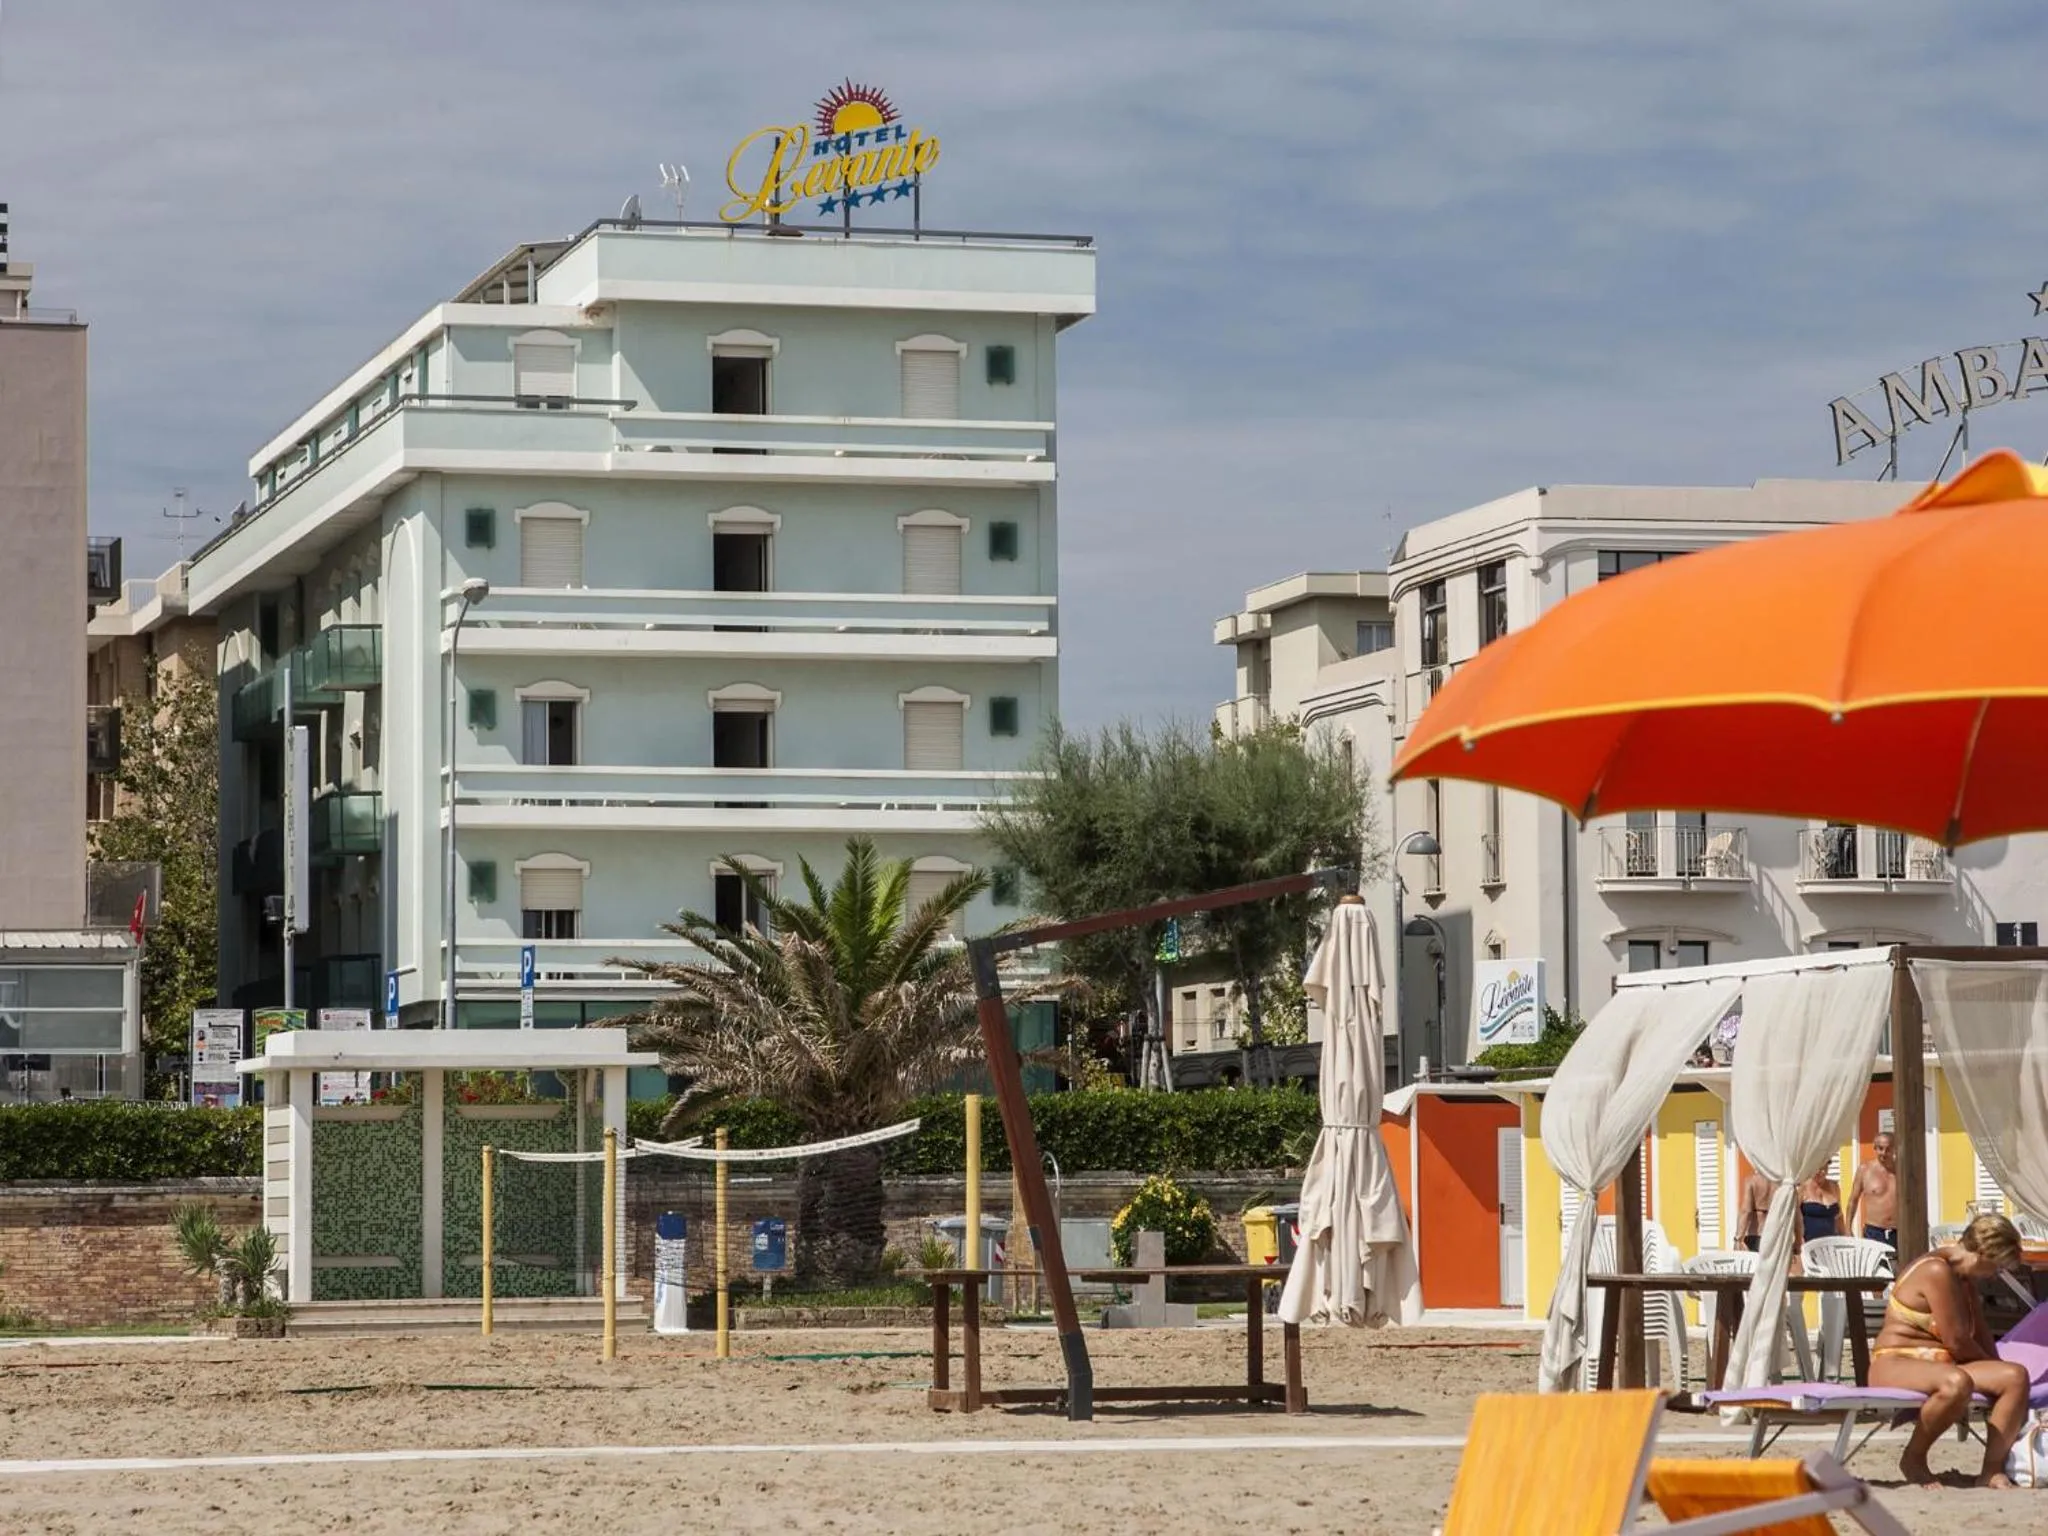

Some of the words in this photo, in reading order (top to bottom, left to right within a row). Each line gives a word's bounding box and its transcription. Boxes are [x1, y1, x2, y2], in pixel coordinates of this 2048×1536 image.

[814, 124, 908, 156] HOTEL
[719, 124, 941, 222] Levante
[523, 950, 532, 985] P
[387, 976, 396, 1011] P
